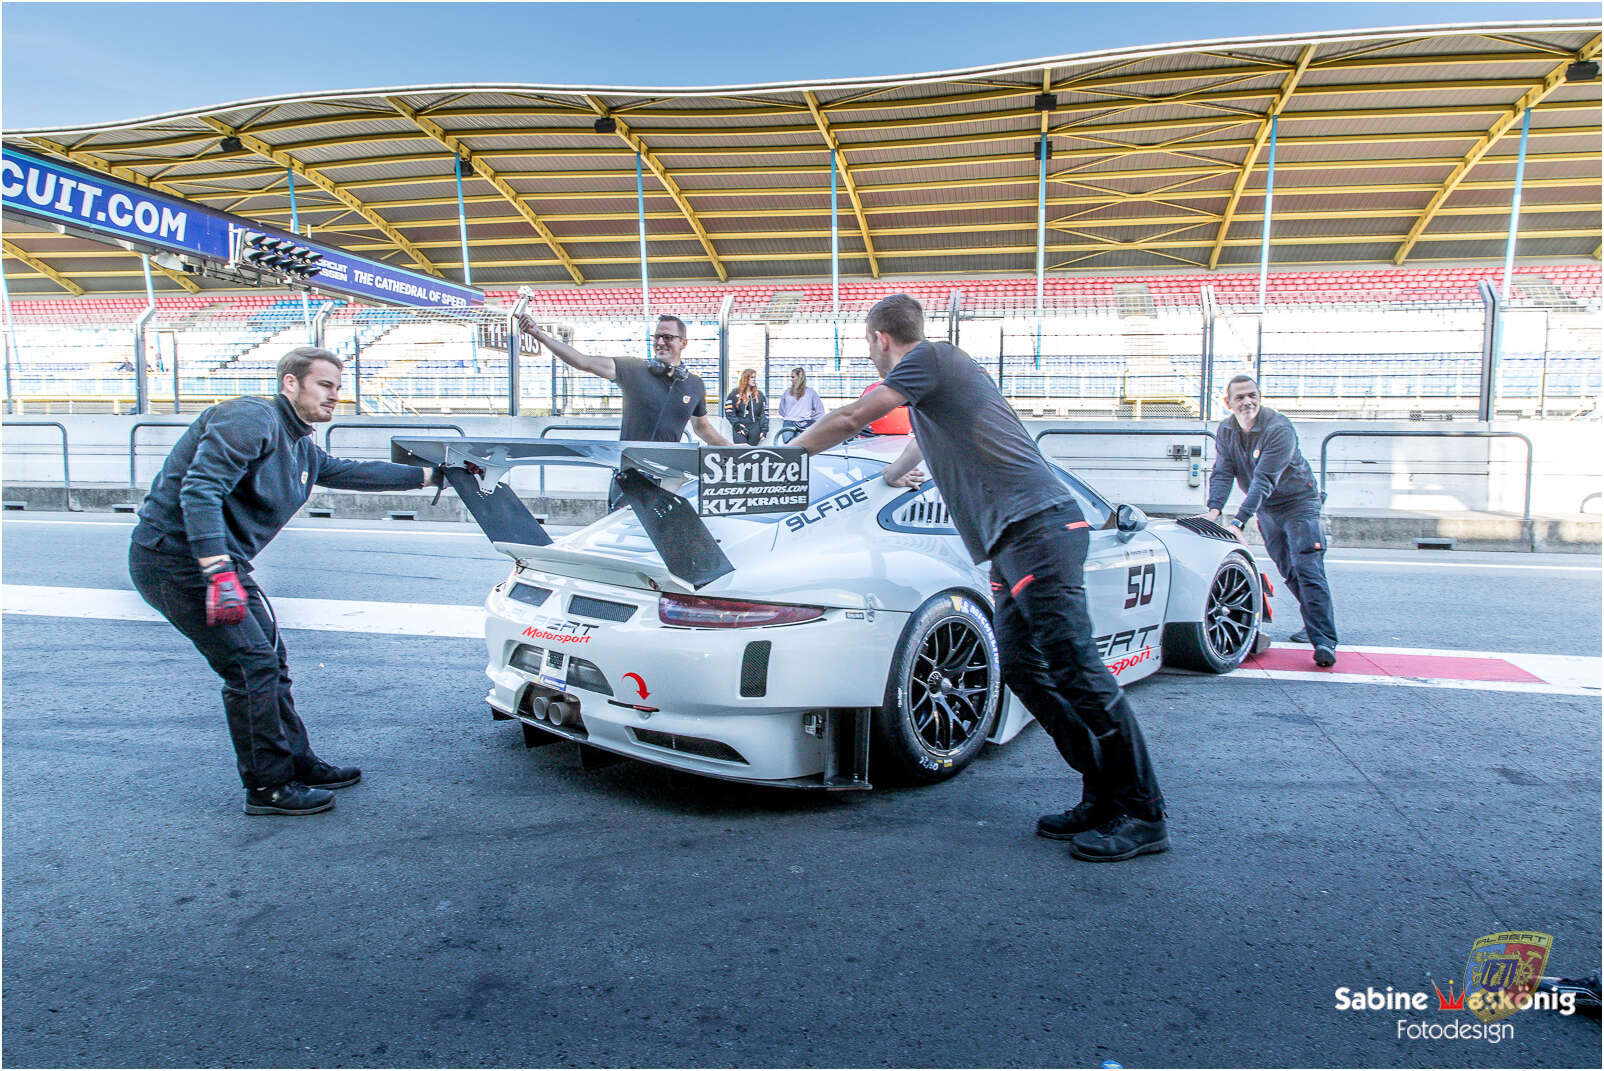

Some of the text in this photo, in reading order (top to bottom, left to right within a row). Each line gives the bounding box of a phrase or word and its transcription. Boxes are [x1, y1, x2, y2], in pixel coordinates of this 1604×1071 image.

[2, 159, 188, 242] CUIT.COM
[312, 259, 348, 273] IRCUIT
[319, 268, 348, 282] SSEN
[353, 269, 467, 307] THE CATHEDRAL OF SPEED
[703, 451, 809, 485] Stritzel
[703, 485, 808, 496] KLASEN MOTORS.COM
[702, 495, 808, 514] KLZ KRAUSE
[785, 487, 869, 533] 9LF.DE
[1124, 563, 1156, 609] 50
[522, 625, 592, 644] Motorsport
